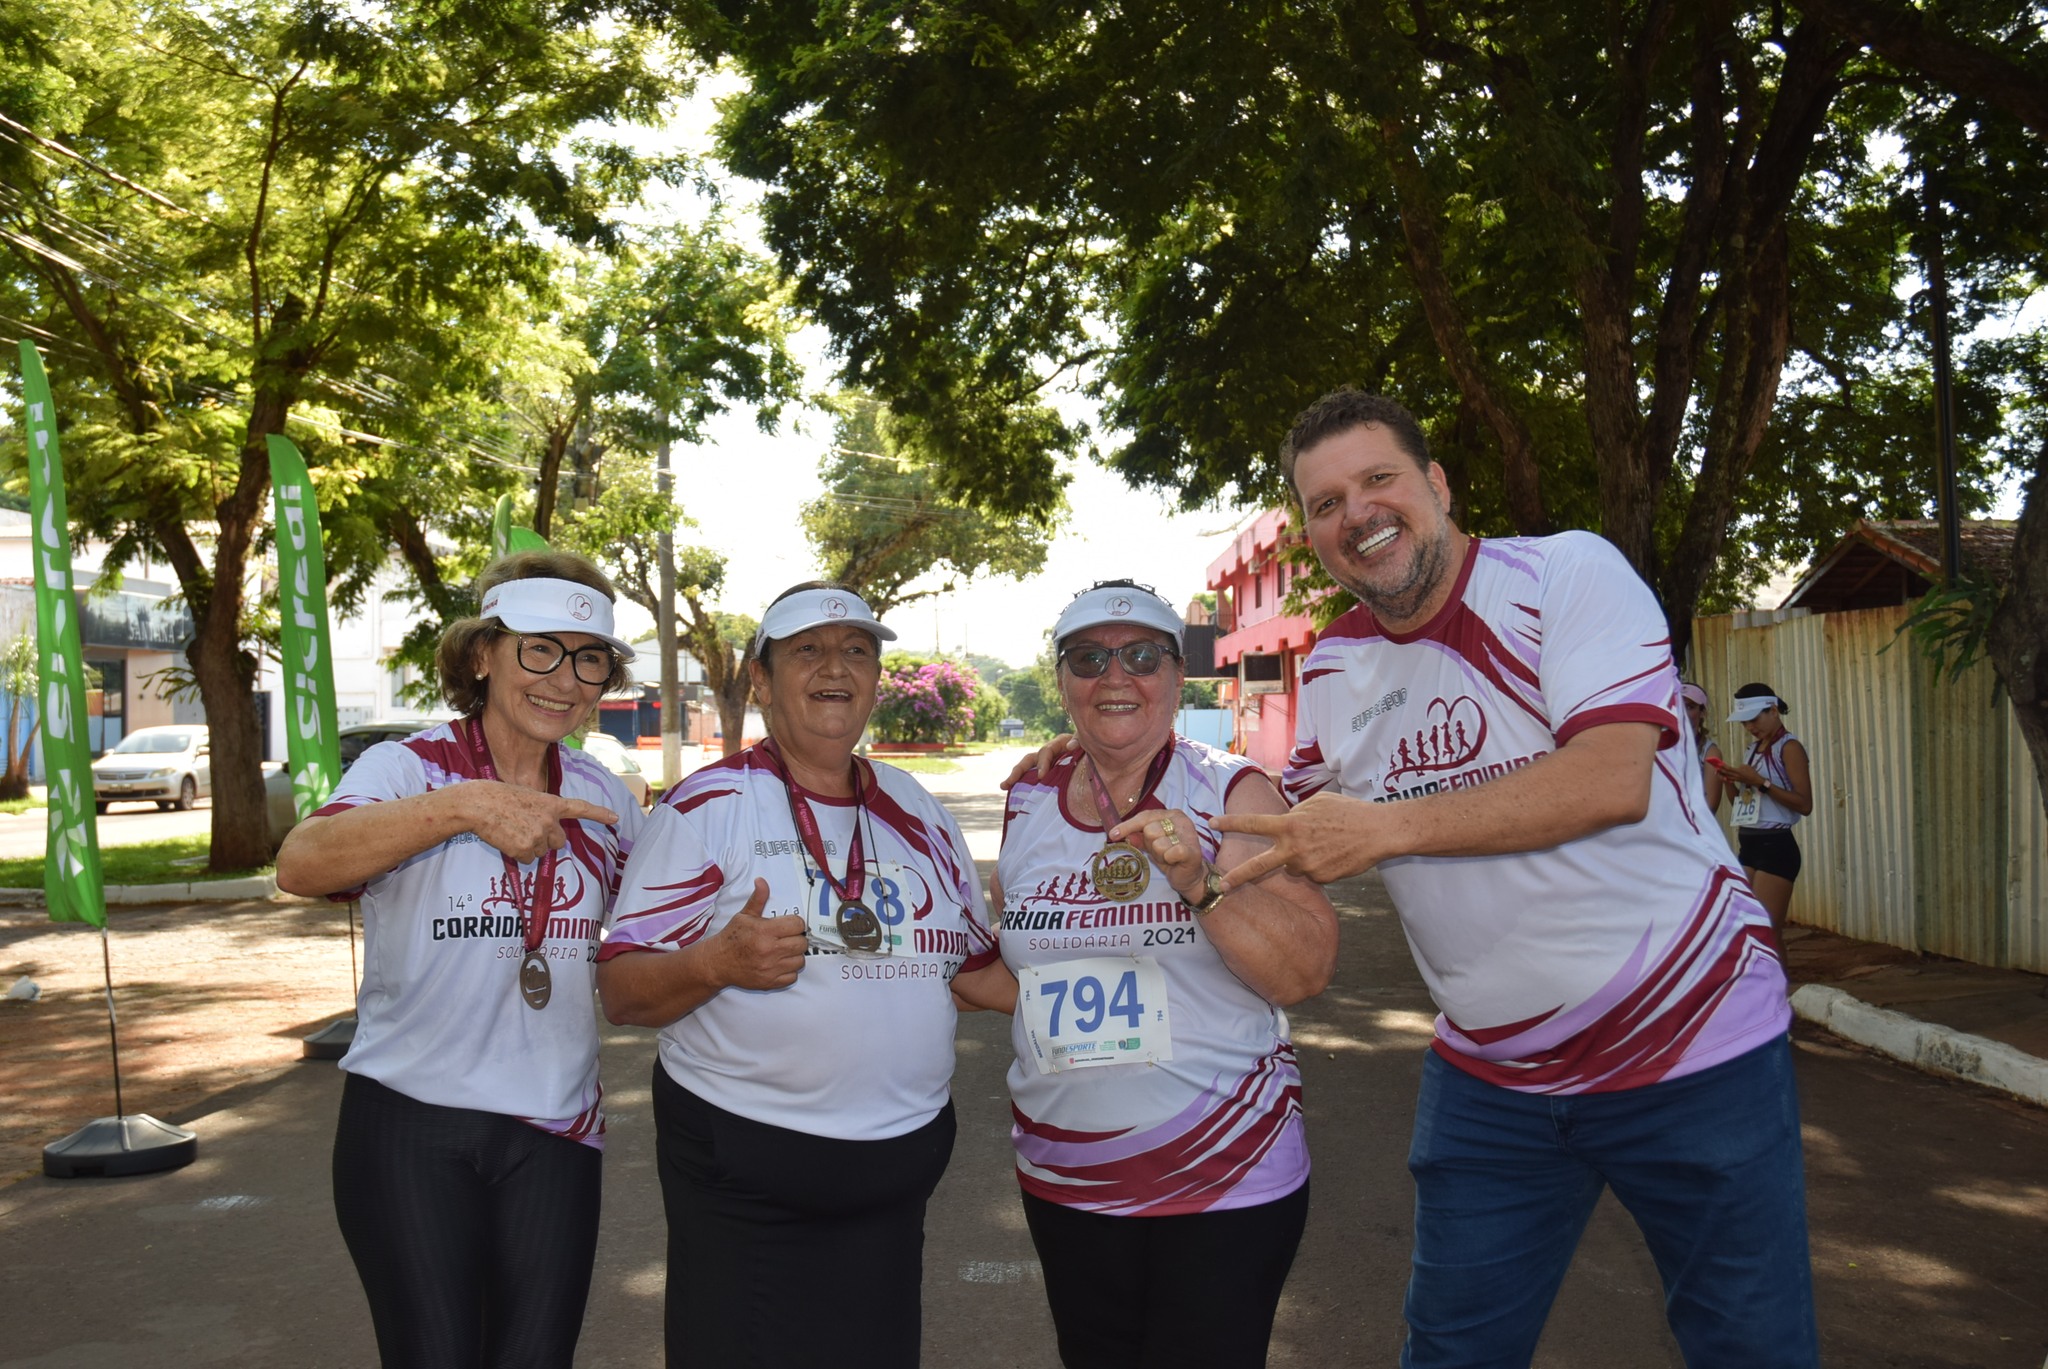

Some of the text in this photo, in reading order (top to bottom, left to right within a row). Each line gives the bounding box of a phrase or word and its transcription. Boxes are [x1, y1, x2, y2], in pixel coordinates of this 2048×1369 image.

[754, 839, 790, 858] EQUIPE
[804, 868, 906, 926] 78
[1029, 926, 1196, 950] SOLIDÁRIA 2024
[841, 960, 939, 980] SOLIDÁRIA
[1041, 970, 1145, 1038] 794
